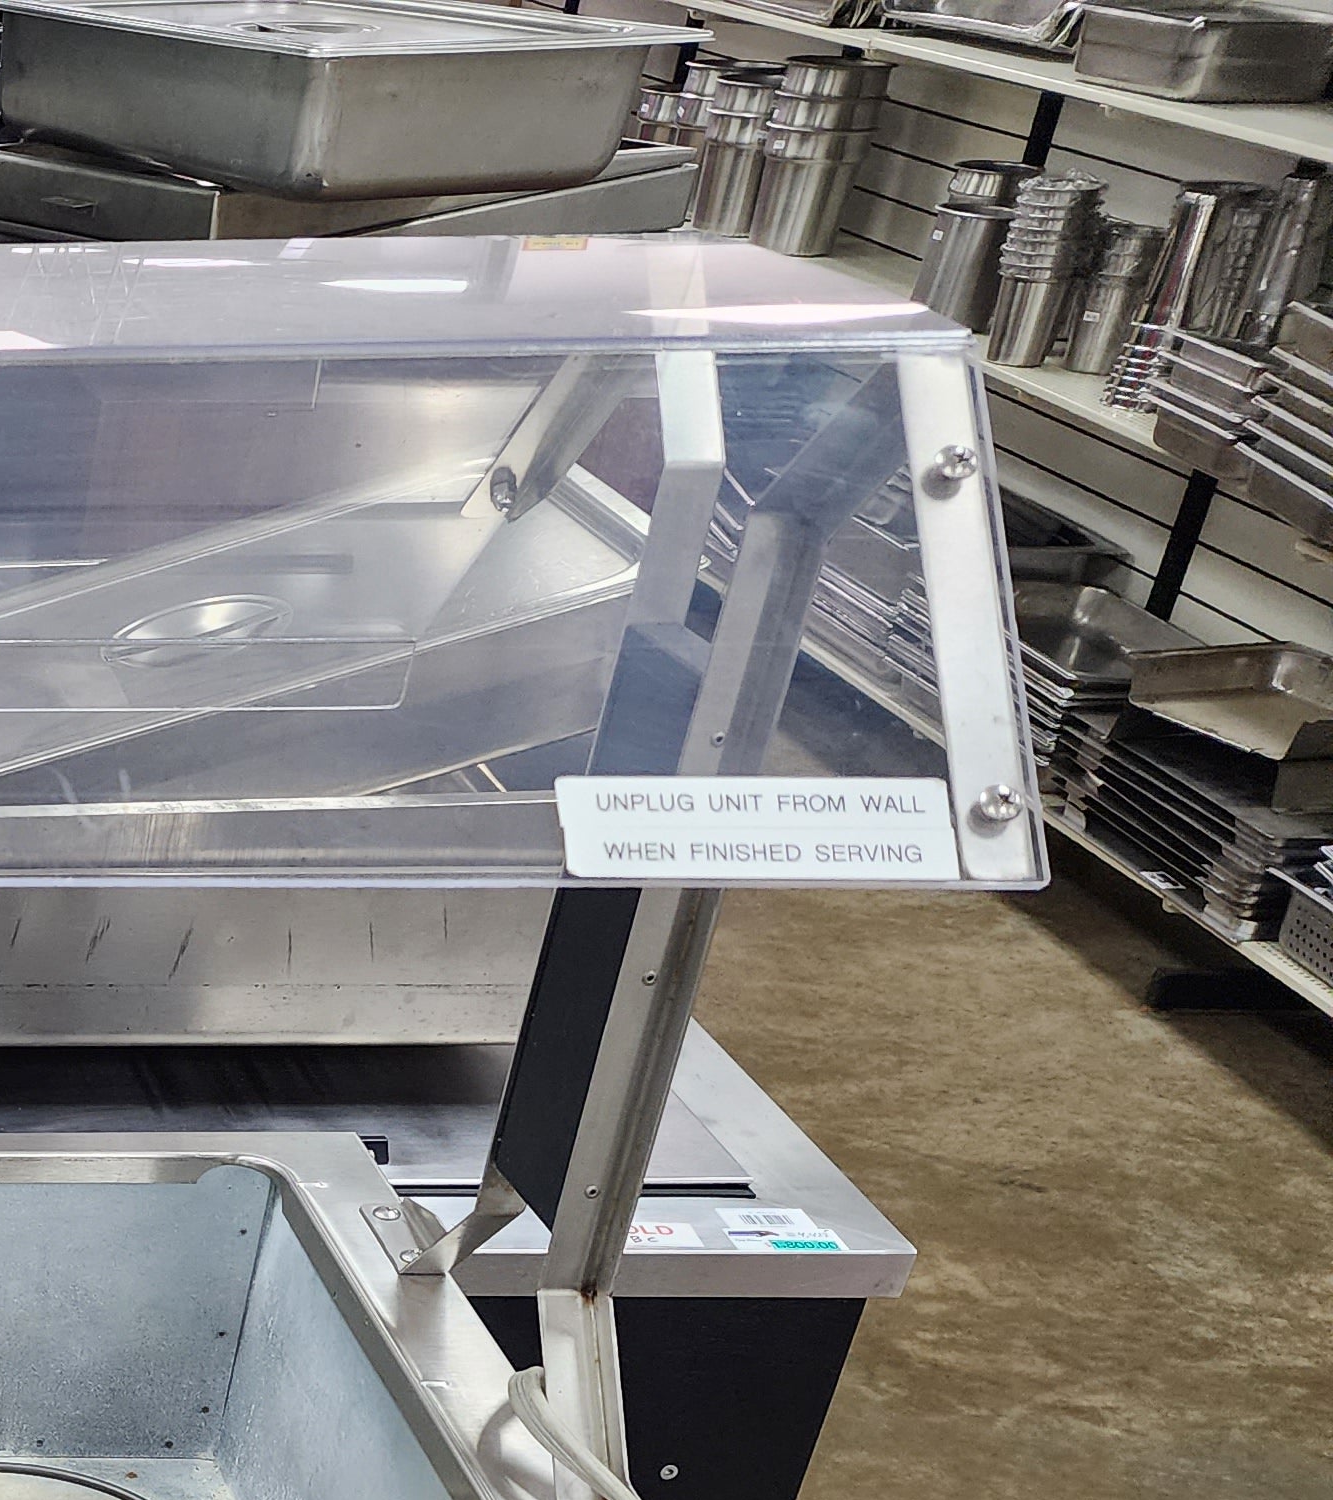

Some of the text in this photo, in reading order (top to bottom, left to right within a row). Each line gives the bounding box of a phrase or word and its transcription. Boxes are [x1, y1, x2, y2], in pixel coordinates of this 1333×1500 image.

[596, 793, 926, 814] UNPLUG UNIT FROM WALL
[604, 841, 923, 864] WHEN FINISHED SERVING
